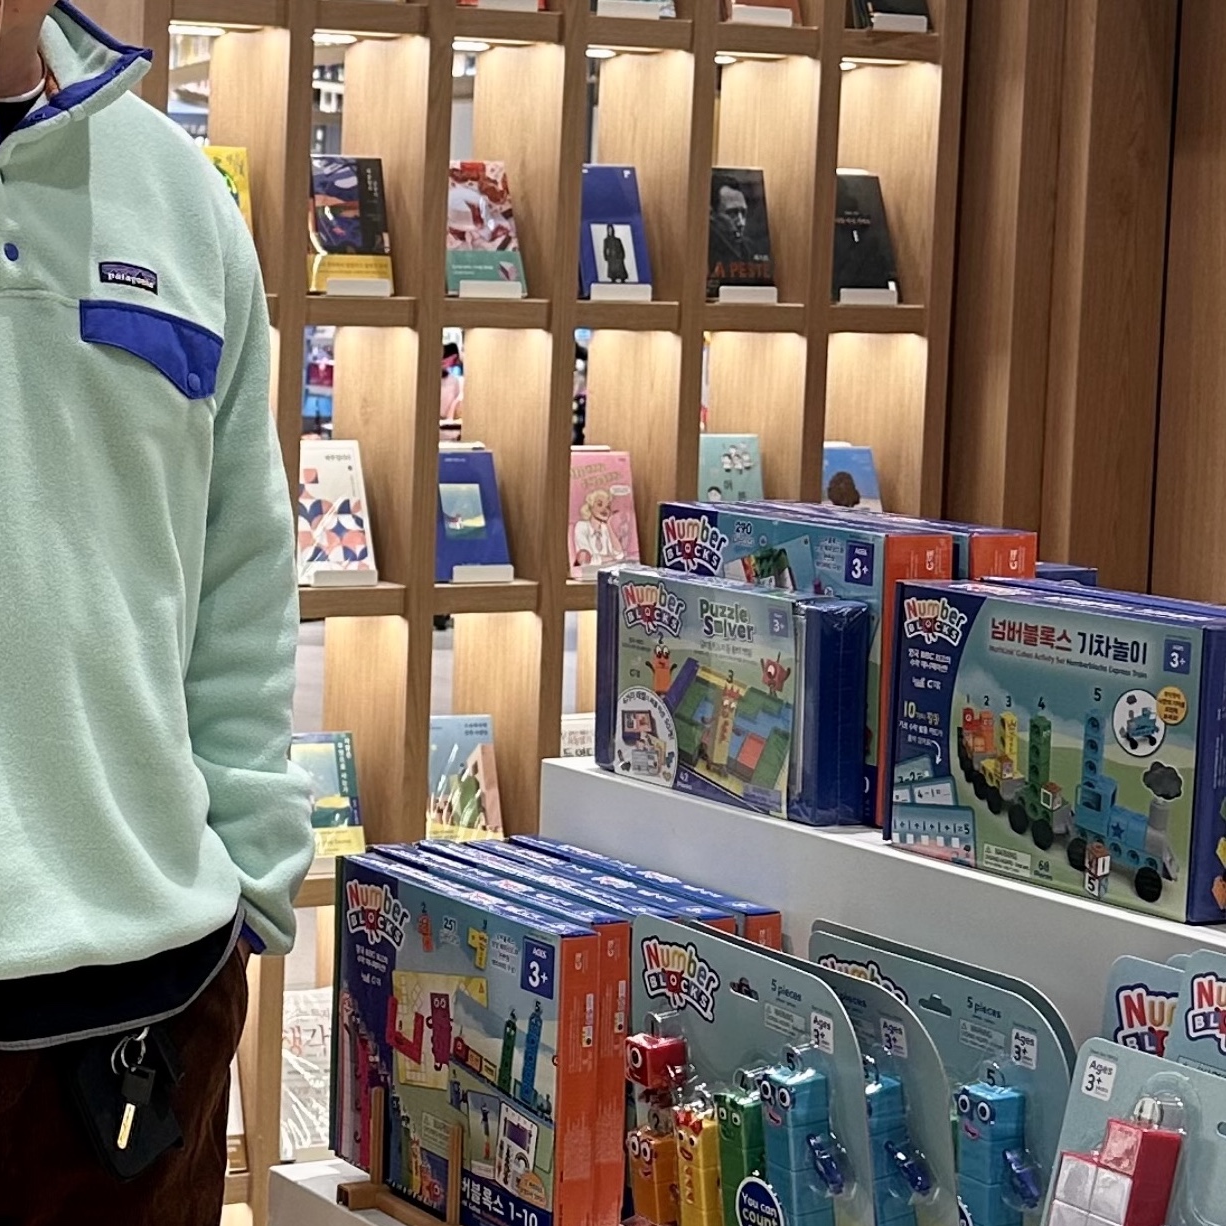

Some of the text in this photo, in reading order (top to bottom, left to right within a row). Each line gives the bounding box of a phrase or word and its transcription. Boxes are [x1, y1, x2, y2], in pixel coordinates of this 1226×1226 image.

[663, 515, 728, 551] Number
[664, 540, 722, 569] BLOCKS
[851, 557, 869, 579] 3+
[622, 582, 685, 616] Number
[698, 598, 749, 624] Puzzle
[904, 597, 967, 629] Number
[905, 618, 961, 644] BLOCKS
[990, 617, 1148, 665] 넘버블록스 기차놀이
[1169, 652, 1186, 669] 3+
[903, 701, 917, 719] 10
[347, 879, 411, 927] Number
[348, 908, 405, 948] BLOCKS
[528, 960, 549, 988] 3+
[644, 939, 718, 992] Number
[647, 970, 714, 1012] BLOCKS
[812, 1016, 831, 1032] Ages
[882, 1021, 903, 1037] Ages
[1013, 1031, 1035, 1048] Ages
[1013, 1044, 1028, 1062] 3+
[986, 1067, 996, 1087] 5
[1088, 1060, 1114, 1076] Ages
[1084, 1073, 1103, 1092] 3+
[461, 1176, 505, 1216] 버블록스
[741, 1191, 777, 1217] You can
